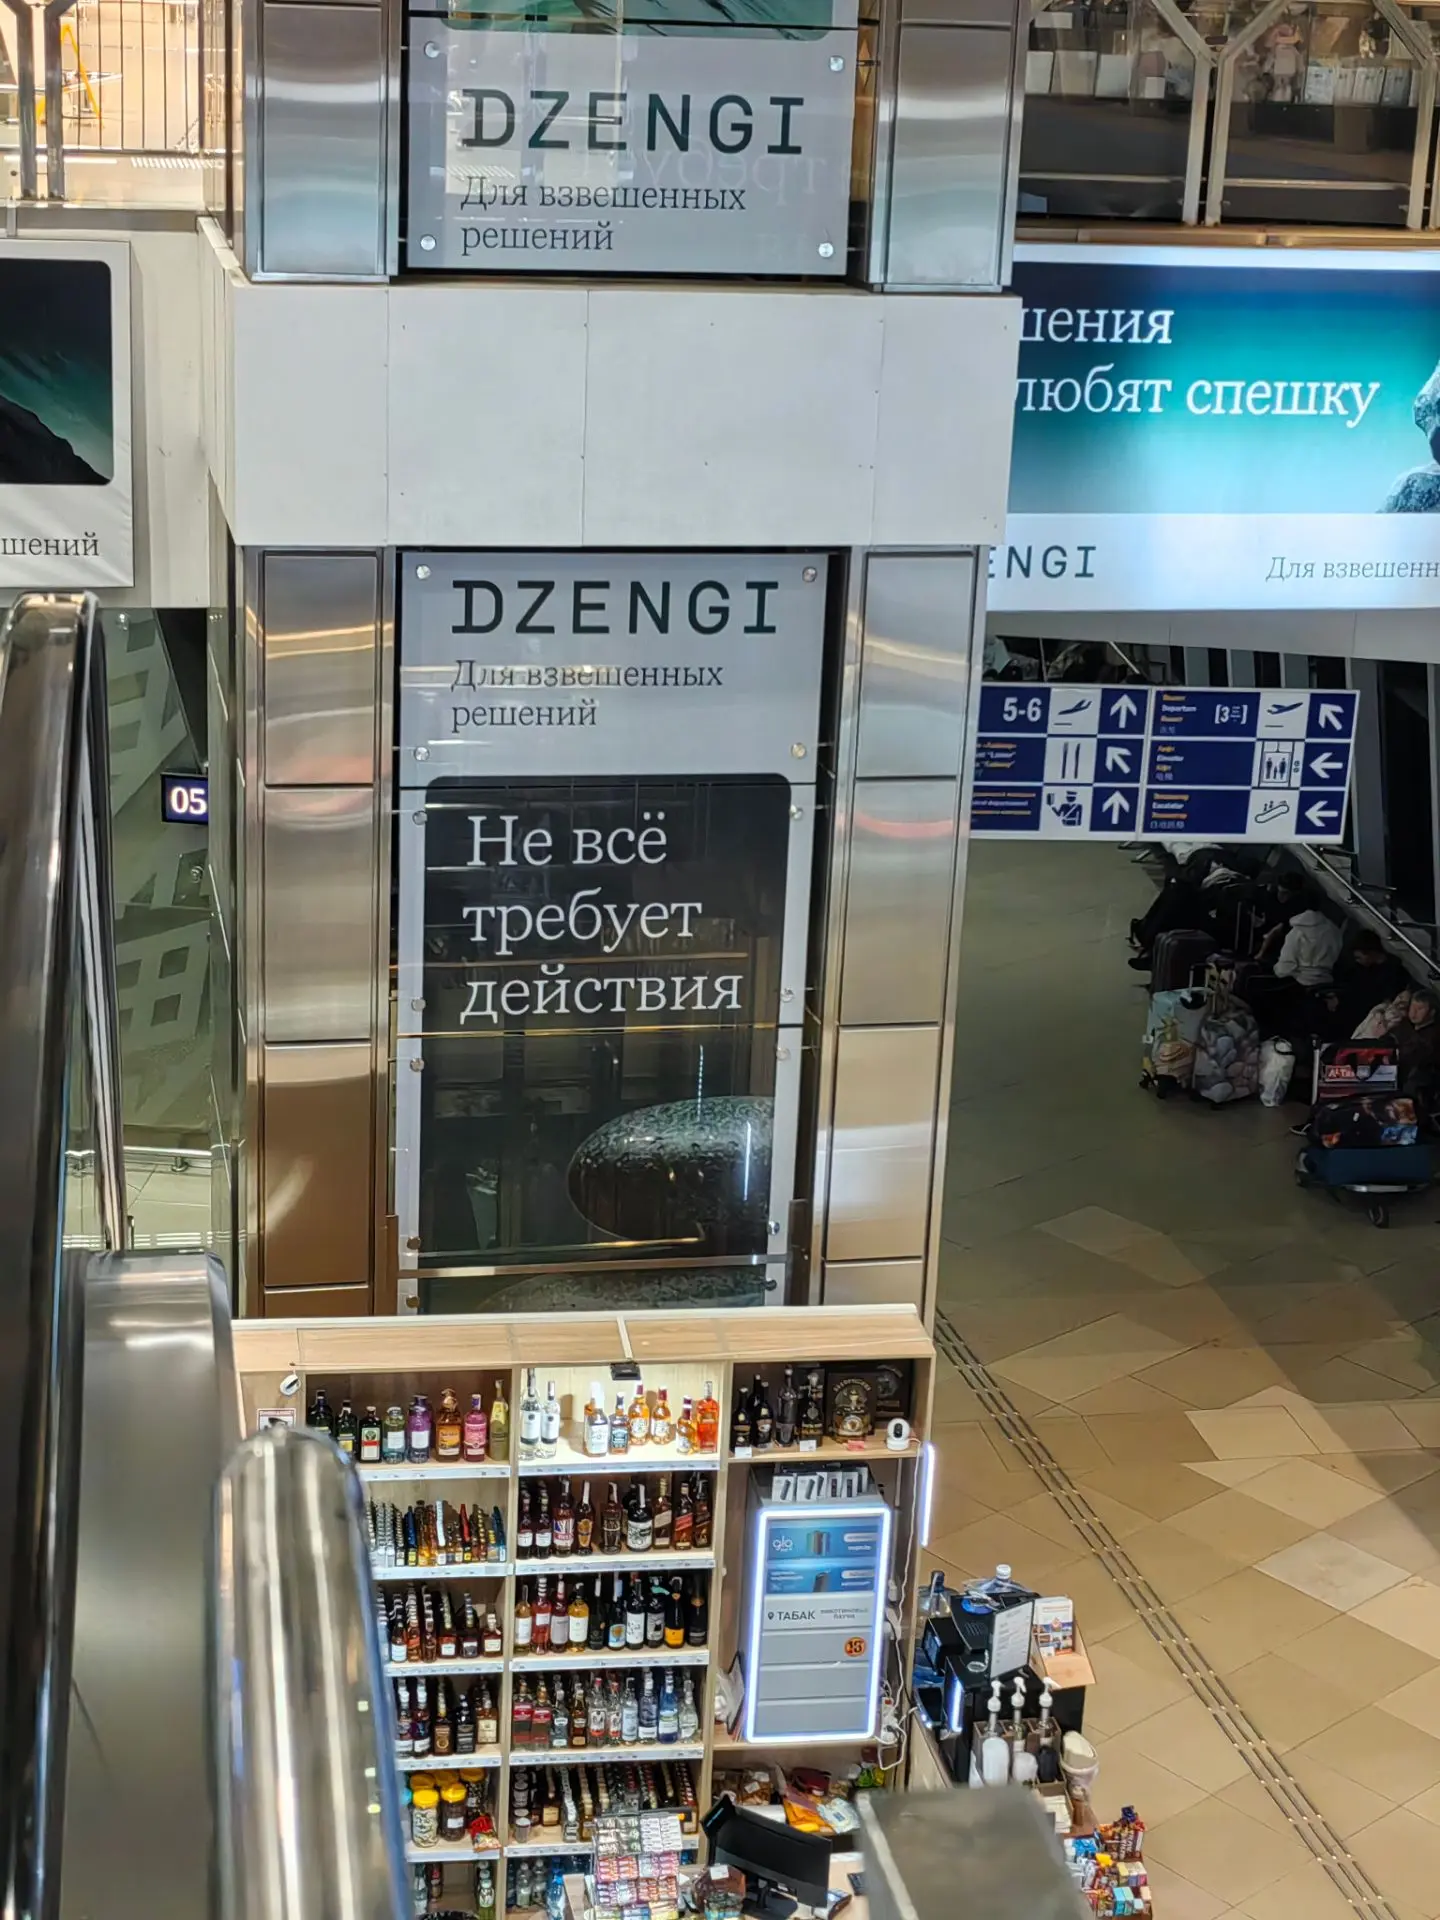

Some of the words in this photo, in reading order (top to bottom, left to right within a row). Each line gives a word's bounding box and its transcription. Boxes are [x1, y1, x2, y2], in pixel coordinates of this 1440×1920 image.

[461, 89, 804, 154] DZENGI
[460, 176, 528, 210] Для
[539, 183, 747, 211] взвешенных
[461, 220, 614, 256] решений
[1020, 308, 1175, 345] шения
[1015, 363, 1172, 413] любят
[1186, 381, 1380, 428] спешку
[1, 531, 100, 556] шений
[1265, 556, 1316, 582] Для
[451, 580, 778, 635] DZENGI
[450, 660, 514, 692] Для
[526, 666, 724, 688] взвешенных
[451, 697, 598, 732] решений
[1002, 697, 1042, 723] 5-6
[171, 786, 208, 815] 05
[466, 815, 553, 867] Не
[573, 811, 668, 866] всё
[462, 887, 703, 955] требует
[459, 964, 743, 1025] действия
[772, 1536, 793, 1551] glo
[777, 1610, 816, 1621] ТАБАК
